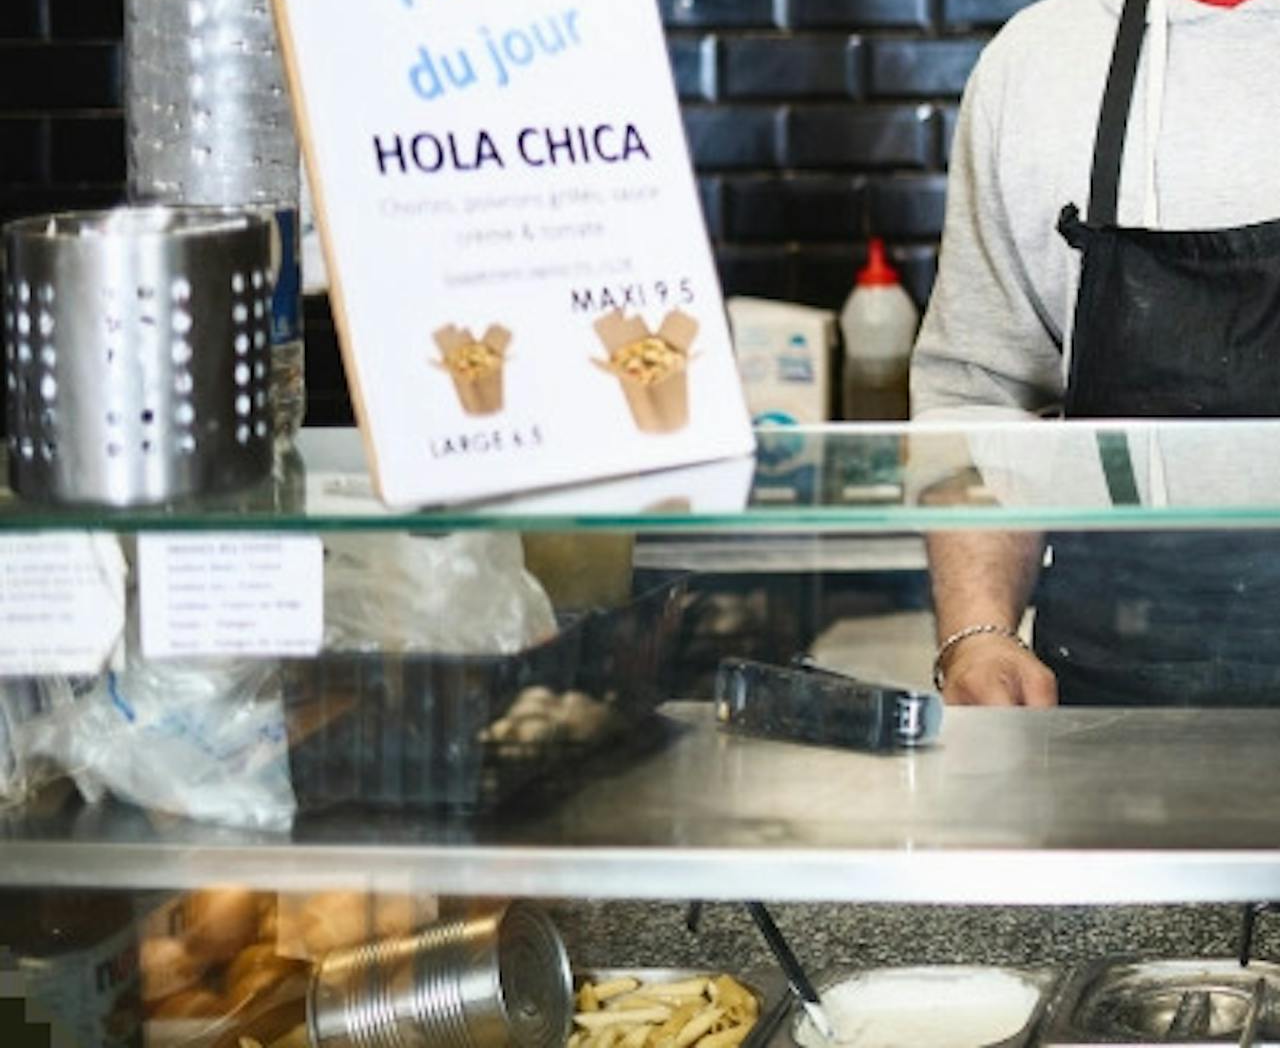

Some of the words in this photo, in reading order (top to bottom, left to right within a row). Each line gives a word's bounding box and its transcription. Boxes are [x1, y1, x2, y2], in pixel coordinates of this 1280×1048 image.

[409, 46, 477, 100] du
[478, 8, 582, 86] jour
[373, 130, 504, 175] HOLA
[517, 123, 651, 167] CHICA
[570, 285, 646, 312] MAXI
[430, 430, 502, 460] LARGE
